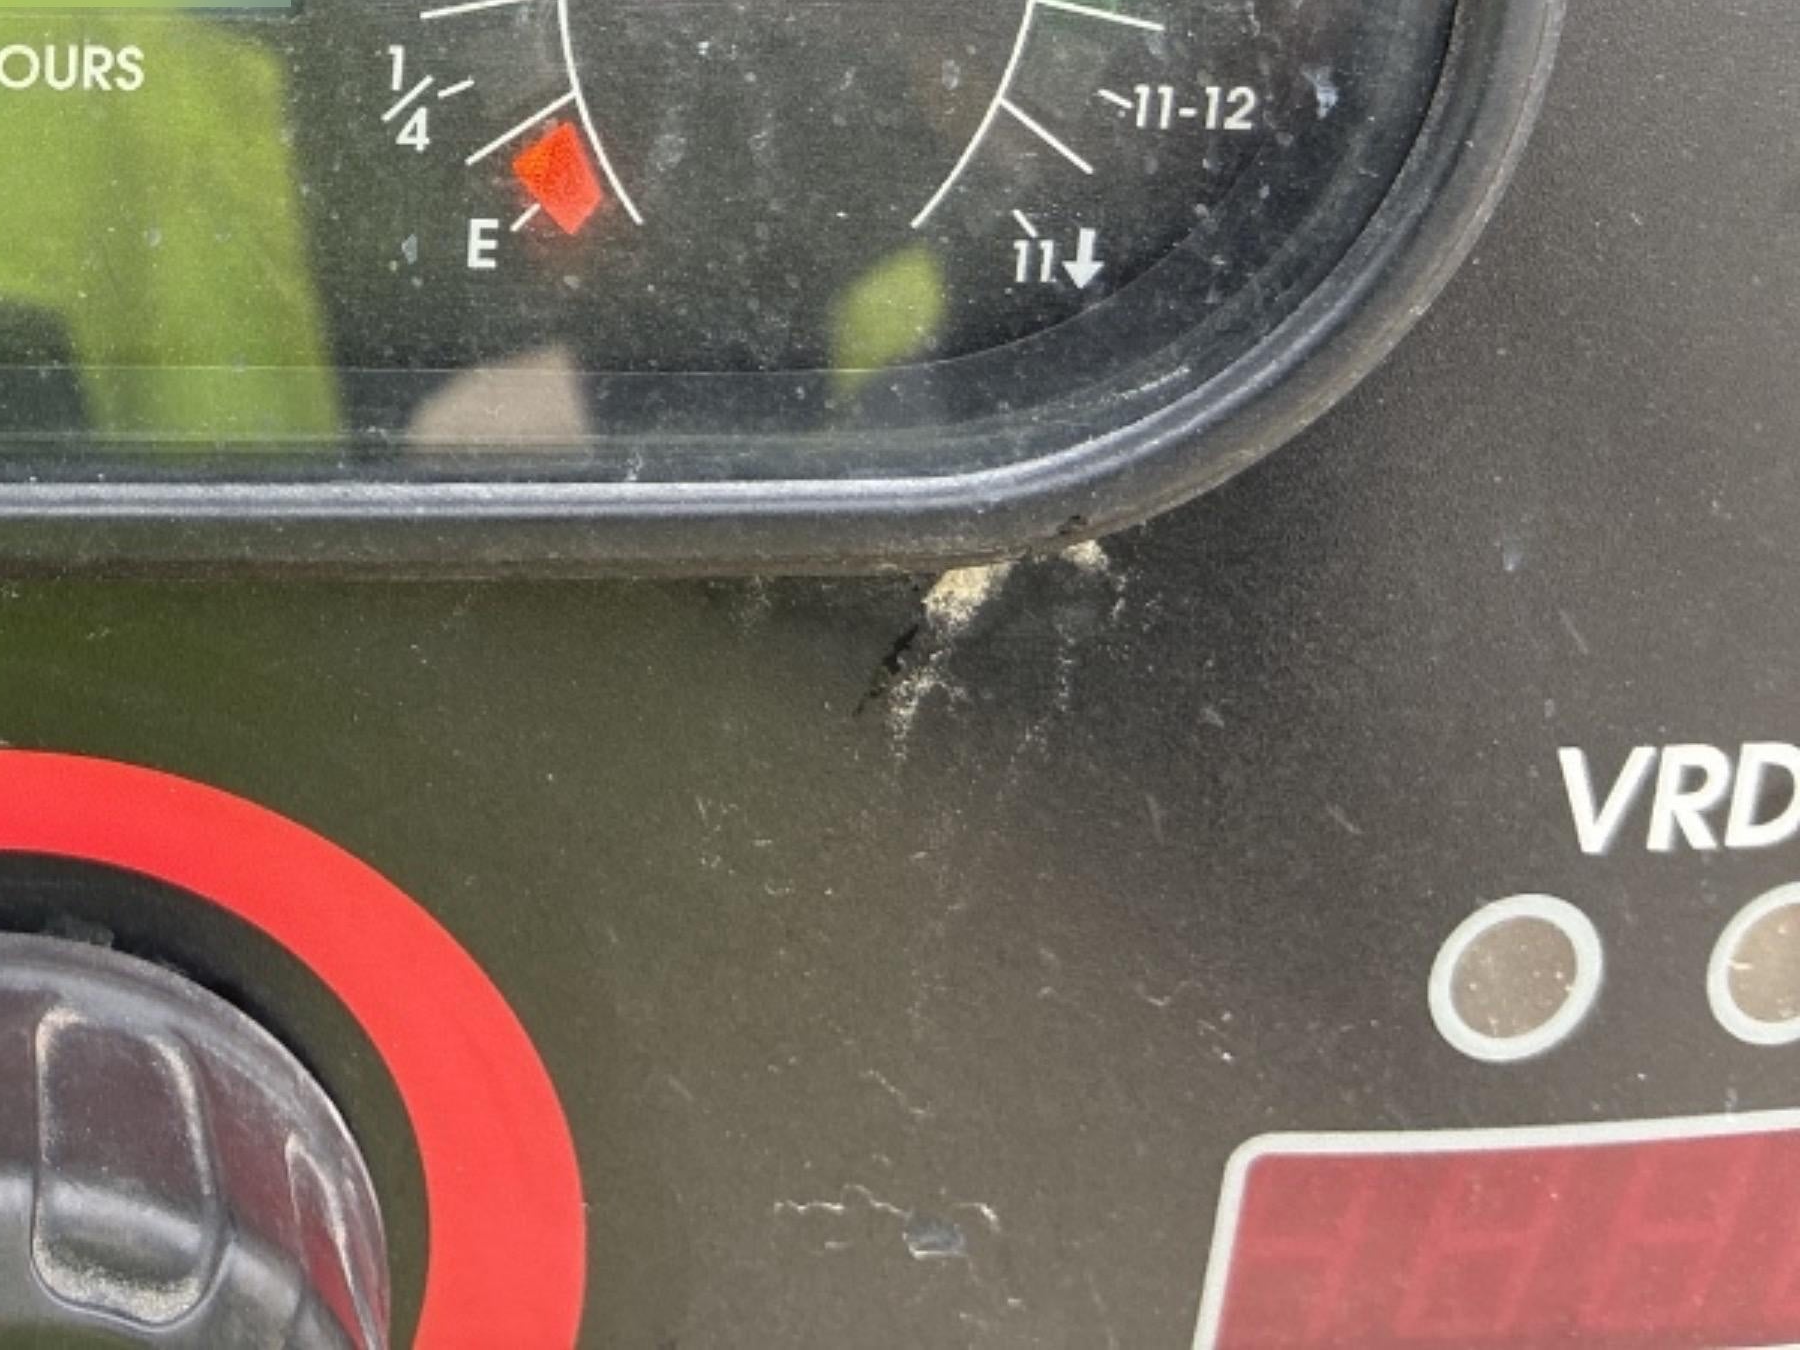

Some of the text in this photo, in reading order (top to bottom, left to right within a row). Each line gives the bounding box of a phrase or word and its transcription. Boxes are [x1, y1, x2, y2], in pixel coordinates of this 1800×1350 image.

[1132, 86, 1256, 131] 11-12
[467, 217, 499, 269] E
[1013, 239, 1054, 283] 11
[1556, 741, 1800, 856] VRD
